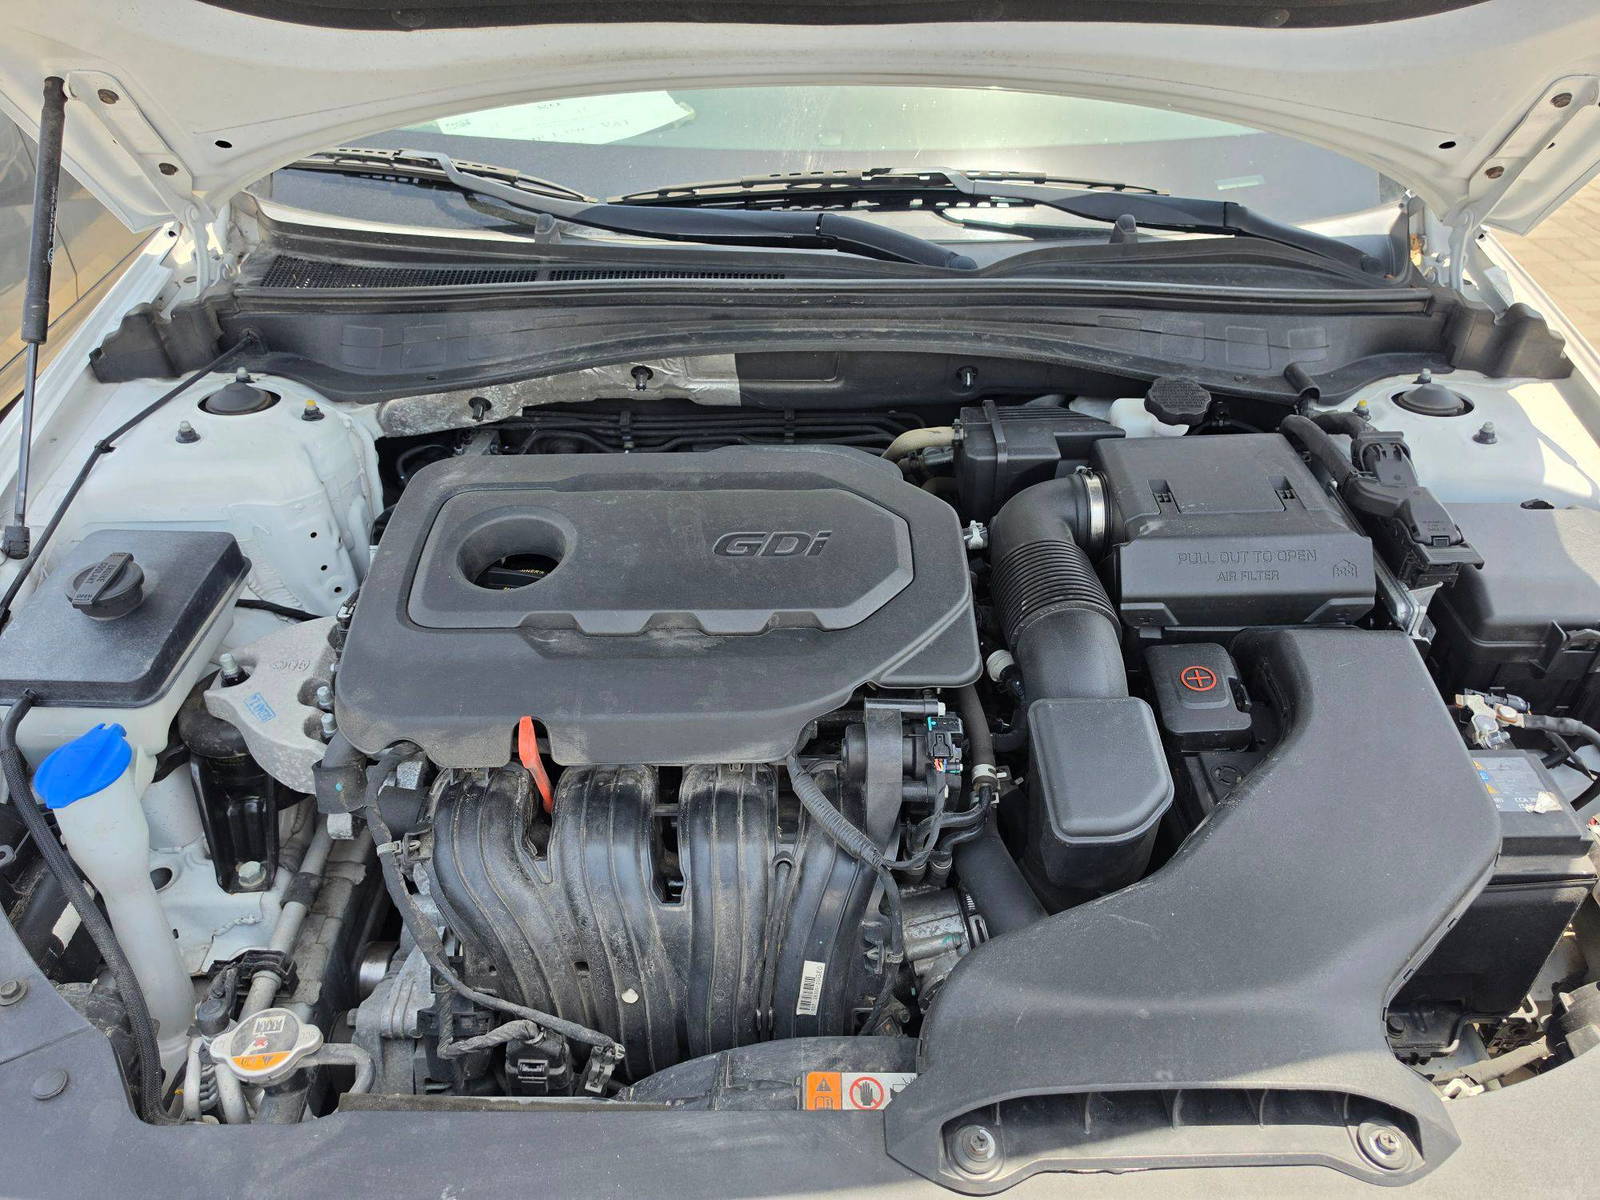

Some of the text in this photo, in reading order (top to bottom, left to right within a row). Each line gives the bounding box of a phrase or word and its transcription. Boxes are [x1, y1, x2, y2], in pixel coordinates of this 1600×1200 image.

[712, 530, 832, 557] GDi
[1178, 549, 1318, 564] PULL OUT TO OPEN
[1217, 570, 1280, 582] AIR FILTER
